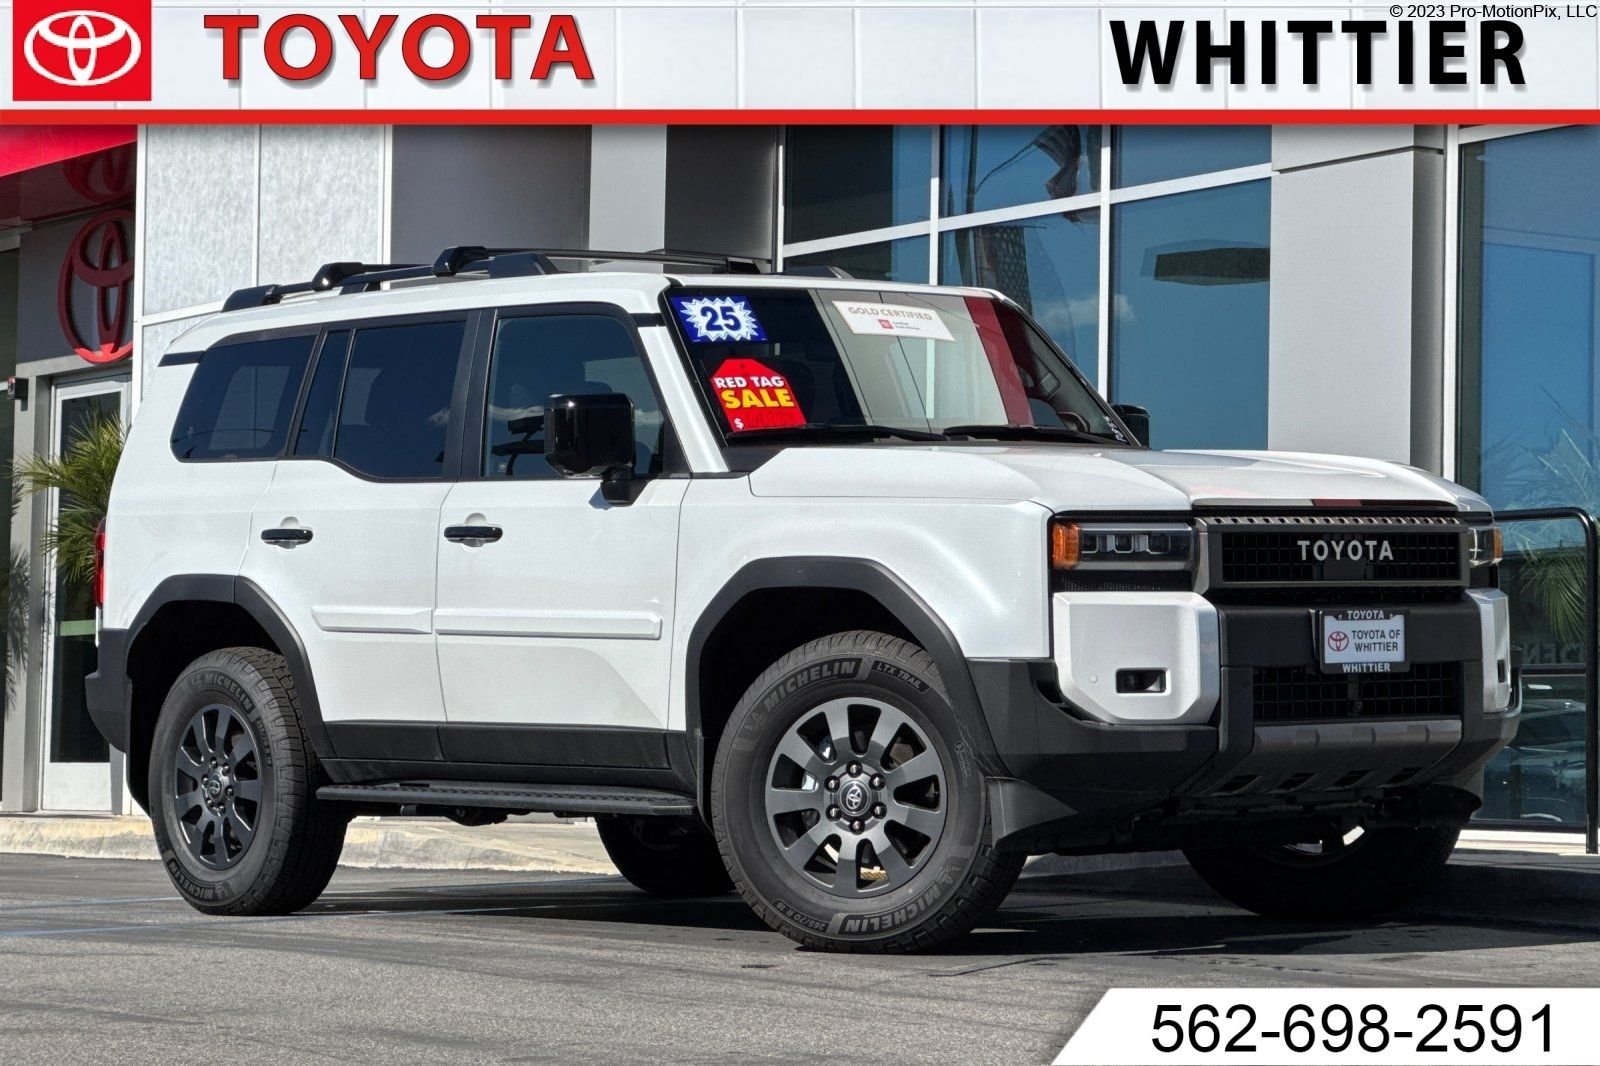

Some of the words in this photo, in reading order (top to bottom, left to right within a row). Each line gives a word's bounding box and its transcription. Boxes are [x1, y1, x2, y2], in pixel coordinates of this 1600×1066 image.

[700, 305, 741, 331] 25
[848, 307, 879, 316] GOLD
[881, 308, 933, 321] CERTIFIED
[714, 377, 747, 389] RED
[750, 376, 785, 388] TAG
[721, 388, 795, 409] SALE
[734, 417, 744, 430] $
[1297, 540, 1394, 562] TOYOTA
[1347, 610, 1385, 620] TOYOTA
[1352, 630, 1386, 640] TOYOTA
[1388, 629, 1401, 639] OF
[1354, 642, 1399, 652] WHITTIER
[876, 662, 897, 677] LTX
[897, 670, 924, 690] TRAIL
[1342, 662, 1391, 673] WHITTIER
[204, 674, 254, 713] MICHELIN
[764, 660, 857, 712] MICHELIN
[168, 860, 214, 899] MICHELIN
[845, 884, 941, 933] MICHELIN
